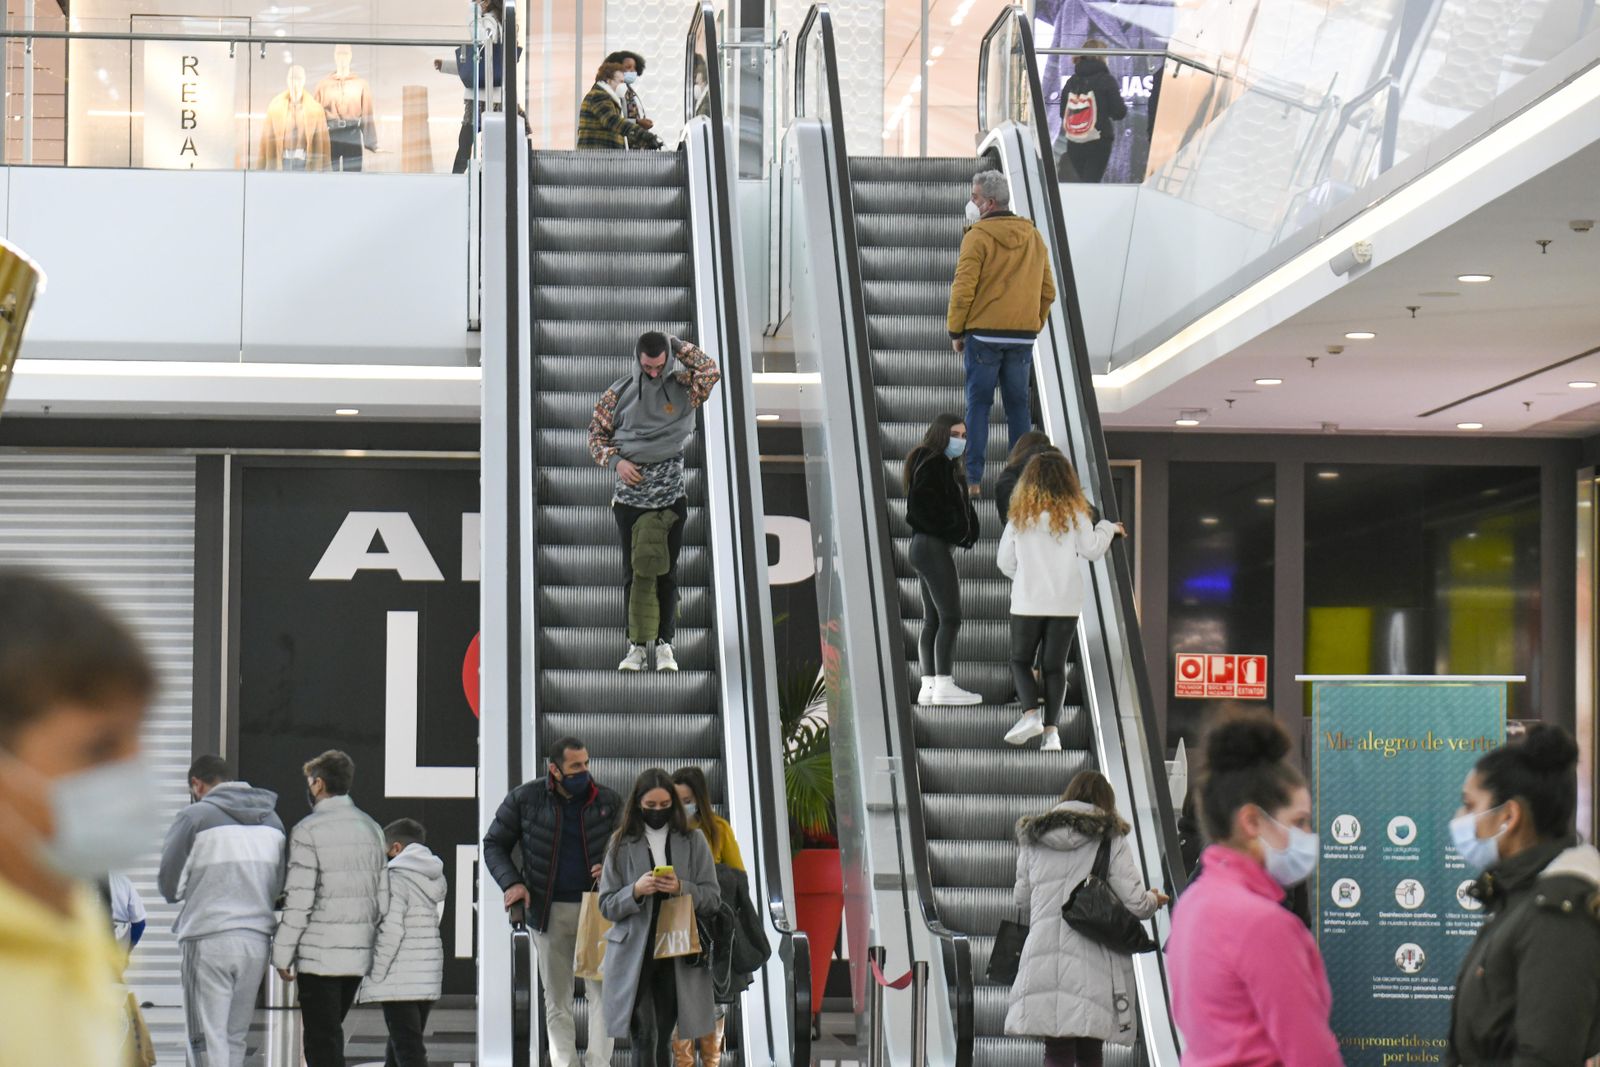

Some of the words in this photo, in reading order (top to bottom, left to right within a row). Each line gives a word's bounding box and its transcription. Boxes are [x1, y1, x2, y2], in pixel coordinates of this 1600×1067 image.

[180, 56, 199, 168] REBA
[1238, 687, 1264, 695] EXTINTOR
[1325, 731, 1352, 750] Me
[1357, 730, 1418, 758] alegro
[1421, 730, 1443, 750] de
[1448, 736, 1497, 751] verte
[1383, 1052, 1404, 1066] por
[1406, 1050, 1440, 1063] todos
